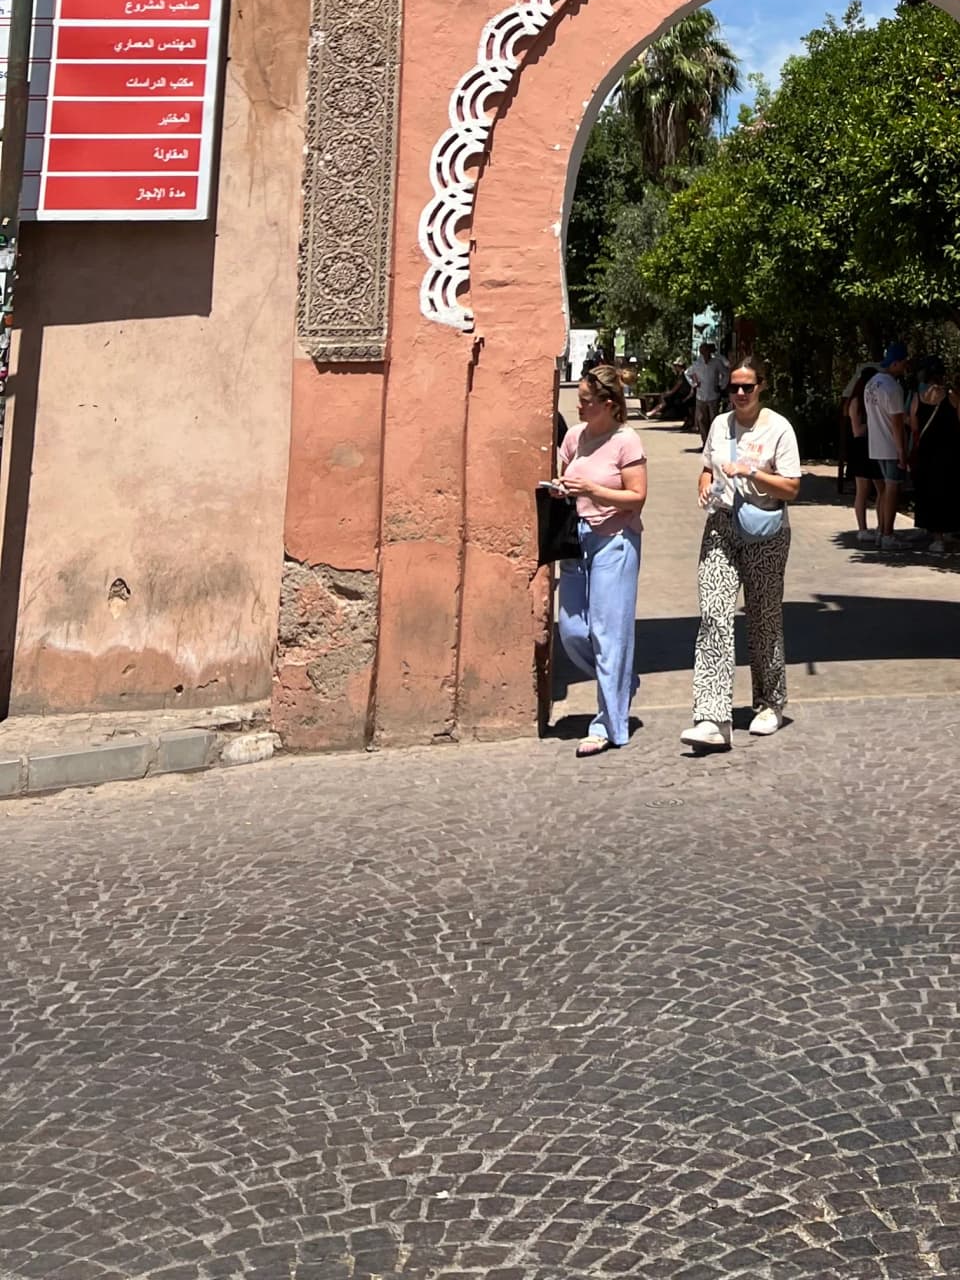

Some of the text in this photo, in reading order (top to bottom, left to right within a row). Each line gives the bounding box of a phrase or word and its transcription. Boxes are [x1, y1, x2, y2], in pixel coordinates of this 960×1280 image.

[125, 0, 165, 14] المشروع
[157, 38, 196, 52] المهندس
[126, 76, 194, 90] مكتب الدراسات
[157, 112, 190, 126] المختبر
[153, 146, 188, 162] المقاولة
[168, 186, 186, 198] مدة
